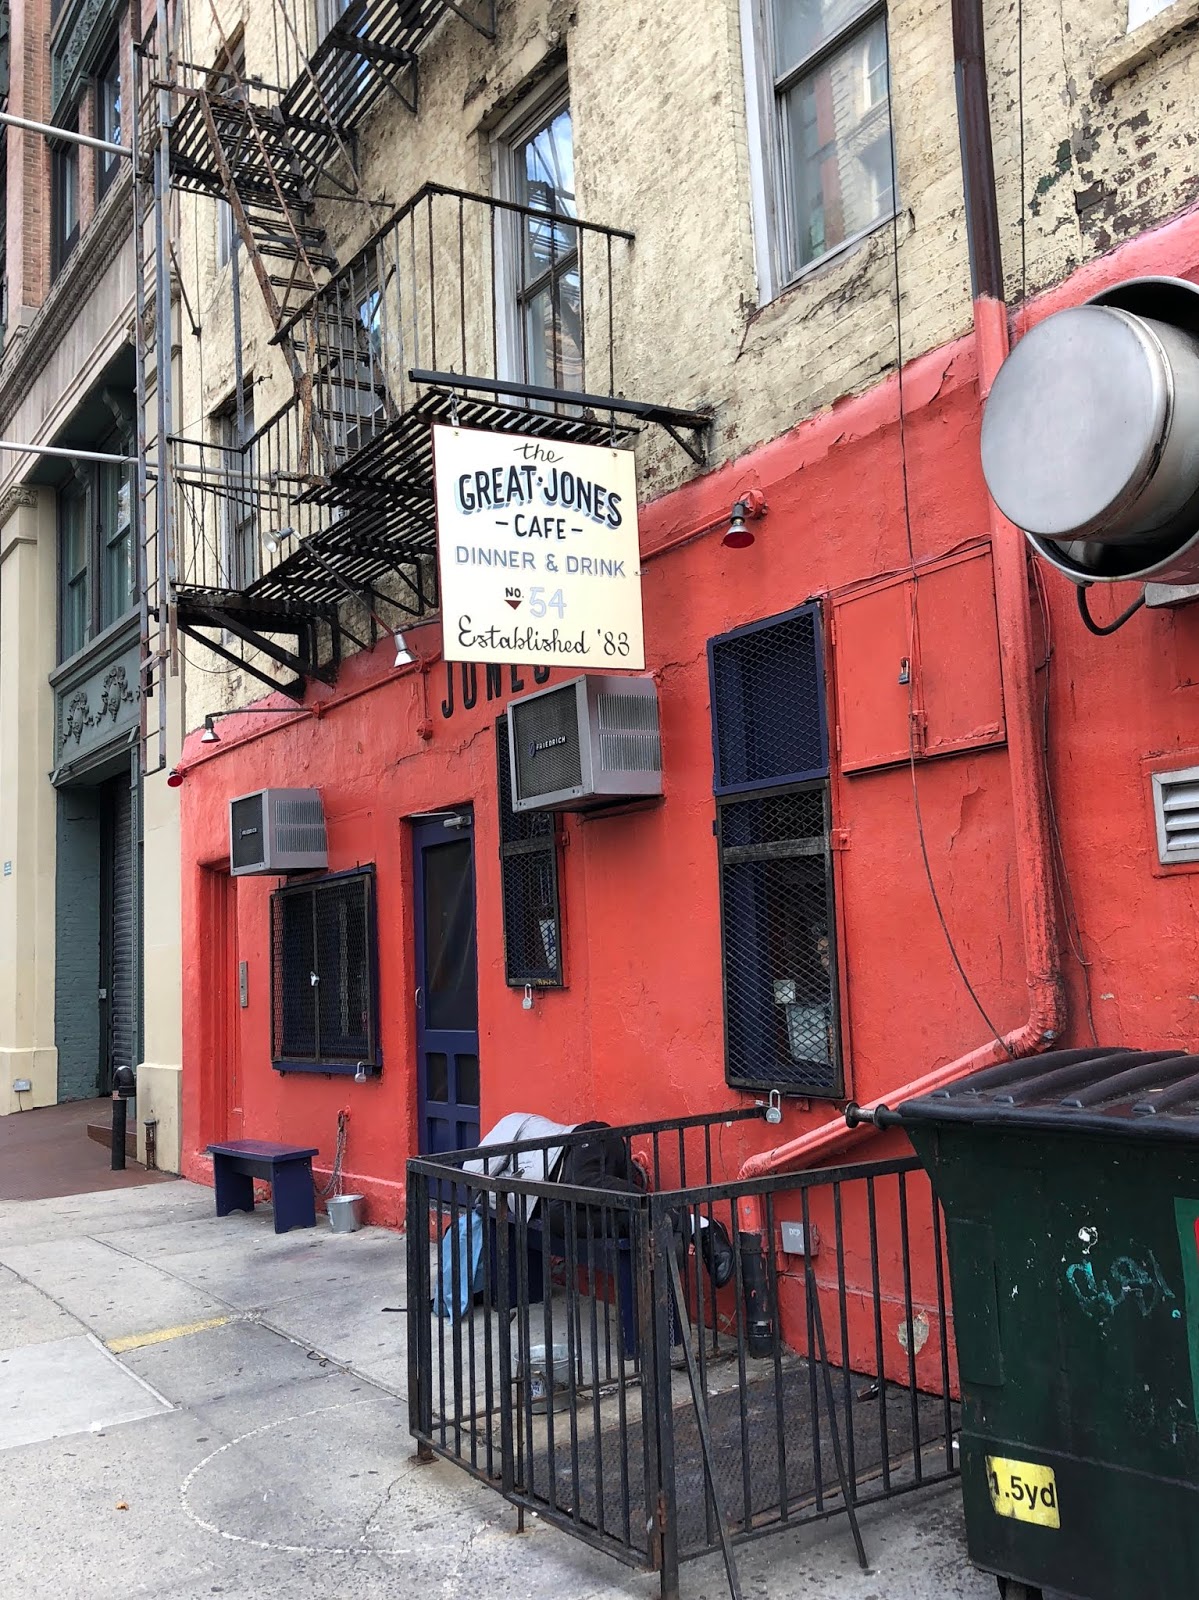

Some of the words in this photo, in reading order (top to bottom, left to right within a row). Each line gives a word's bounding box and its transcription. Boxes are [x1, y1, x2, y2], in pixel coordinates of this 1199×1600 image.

[513, 443, 564, 463] the
[456, 546, 535, 569] DINNER
[546, 554, 559, 572] &
[567, 555, 625, 577] DRINK
[530, 587, 567, 619] 54
[458, 615, 590, 655] Established
[597, 629, 630, 656] '83
[990, 1471, 1056, 1510] 1.5yd
